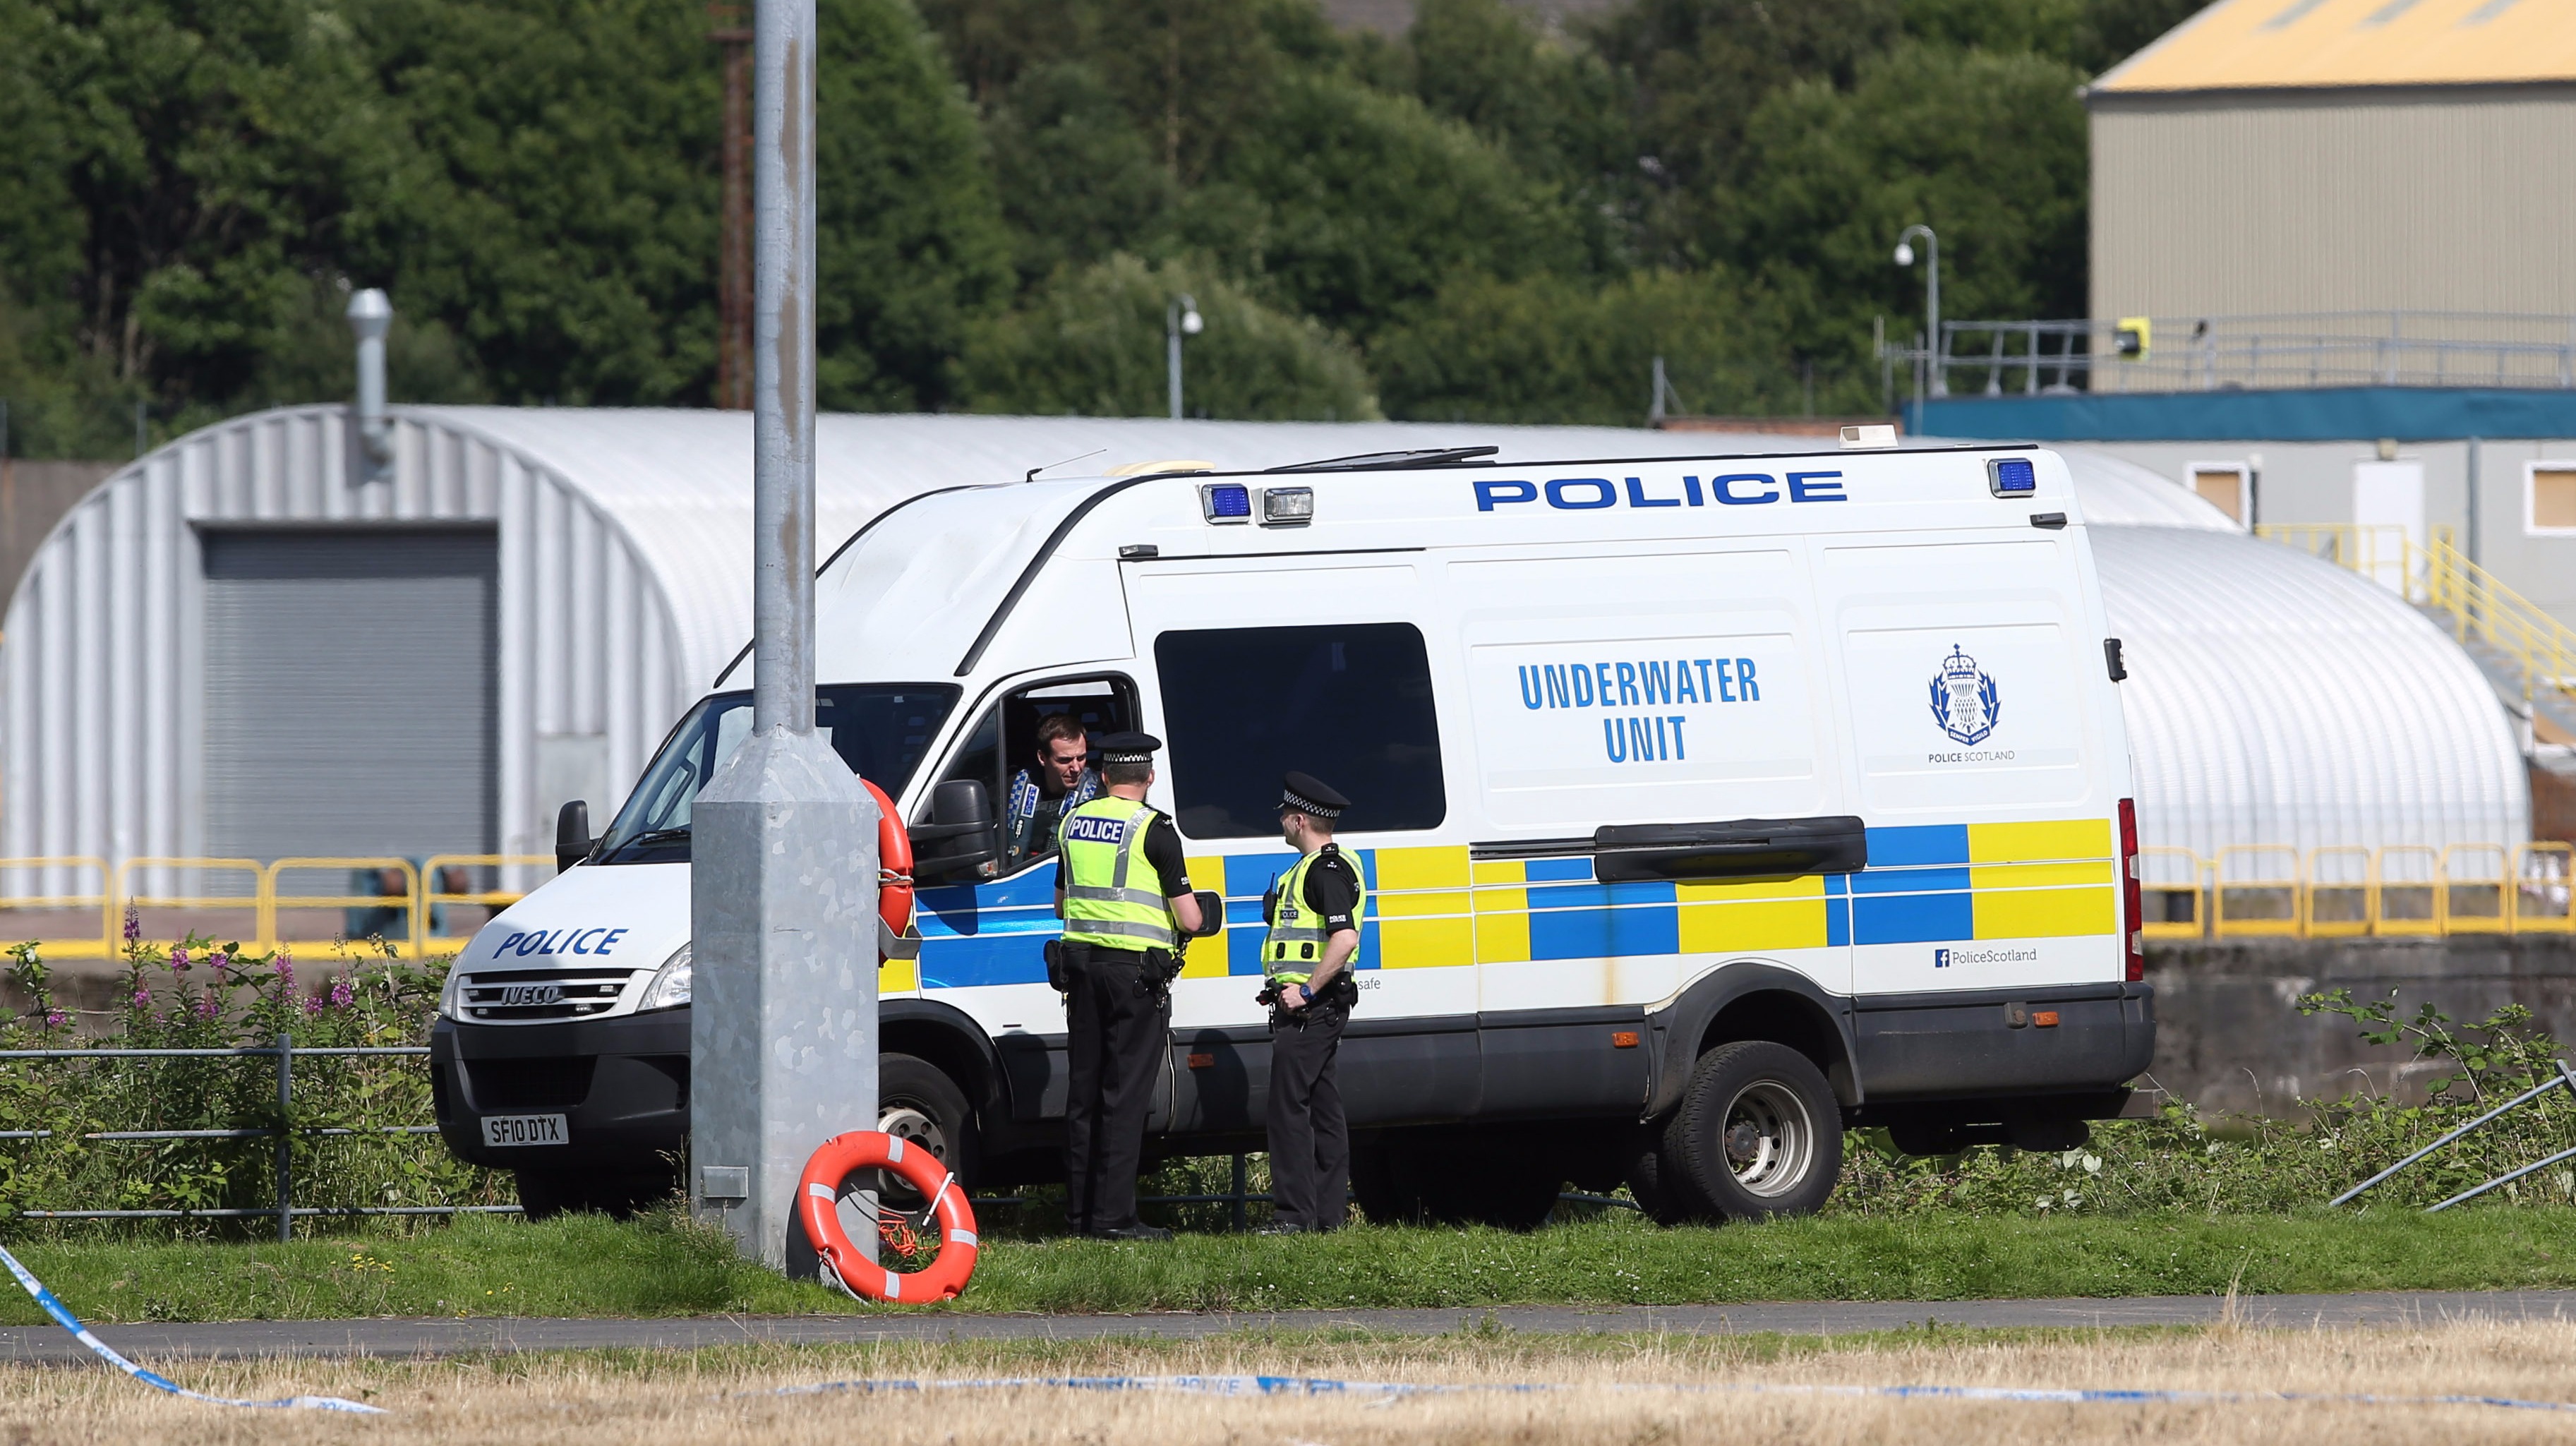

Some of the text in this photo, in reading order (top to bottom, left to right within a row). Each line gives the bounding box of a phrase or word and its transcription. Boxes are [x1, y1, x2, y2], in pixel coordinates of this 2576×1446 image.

[1472, 471, 1848, 512] POLICE
[1518, 658, 1760, 710] UNDERWATER
[1603, 716, 1686, 764] UNIT
[1949, 730, 1970, 744] SEMPER
[1928, 750, 2015, 763] POLICE SCOTLAND
[1069, 819, 1123, 841] POLICE
[492, 928, 630, 959] POLICE
[1952, 948, 2037, 964] PoliceScotland
[1358, 977, 1381, 990] safe
[501, 986, 558, 1004] IVECO
[490, 1117, 560, 1143] SF10 DTX
